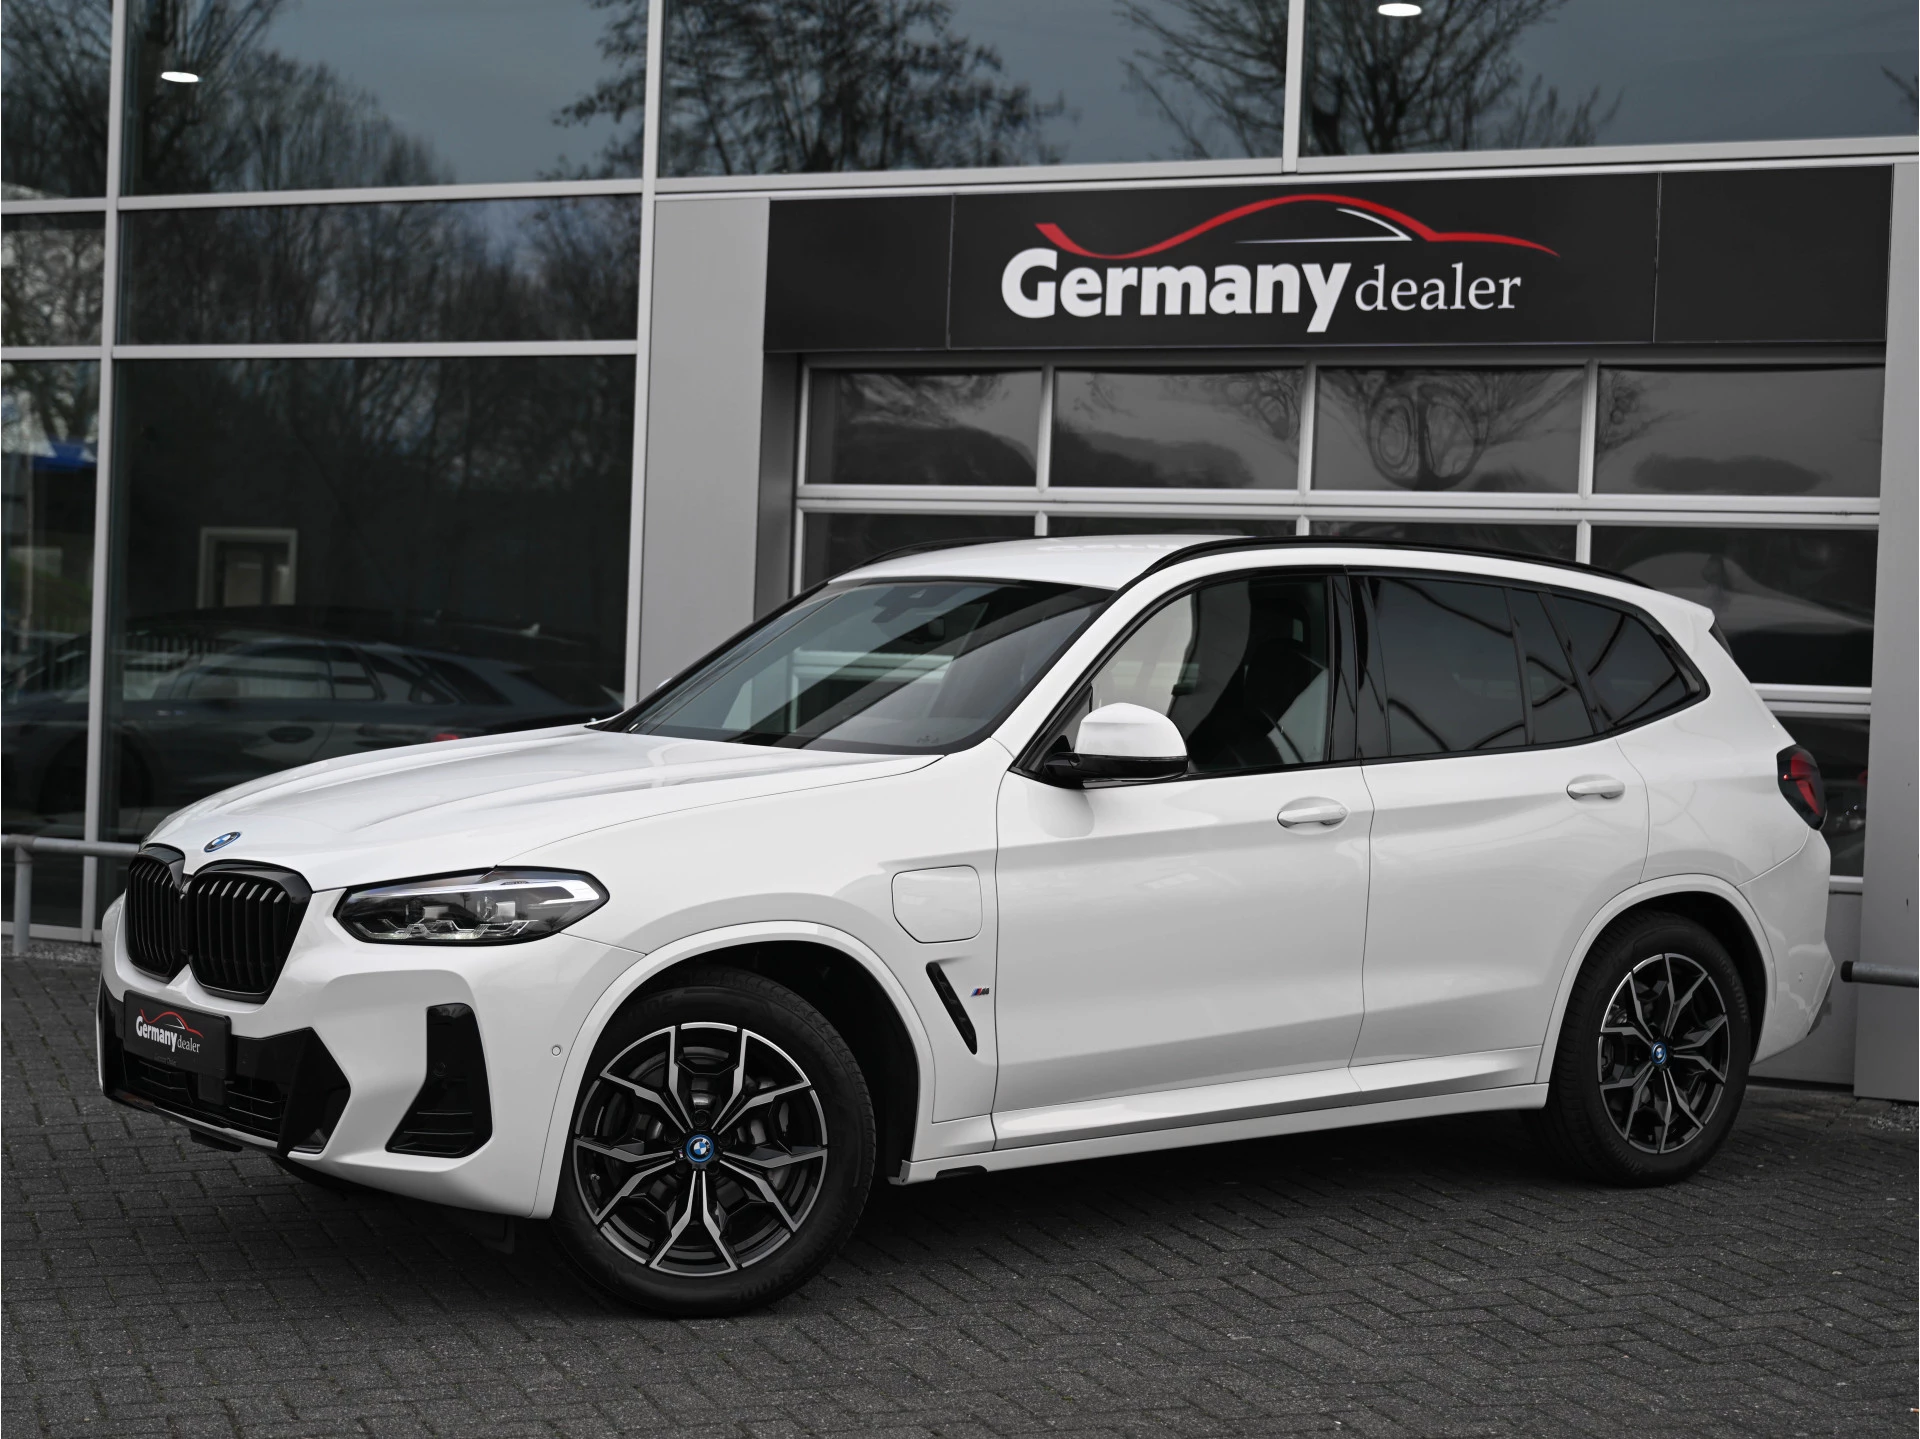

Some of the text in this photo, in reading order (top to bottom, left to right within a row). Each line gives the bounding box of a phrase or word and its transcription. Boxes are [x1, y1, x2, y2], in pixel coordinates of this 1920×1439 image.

[1001, 247, 1522, 333] Germany dealer
[136, 1015, 201, 1053] Germany dealer
